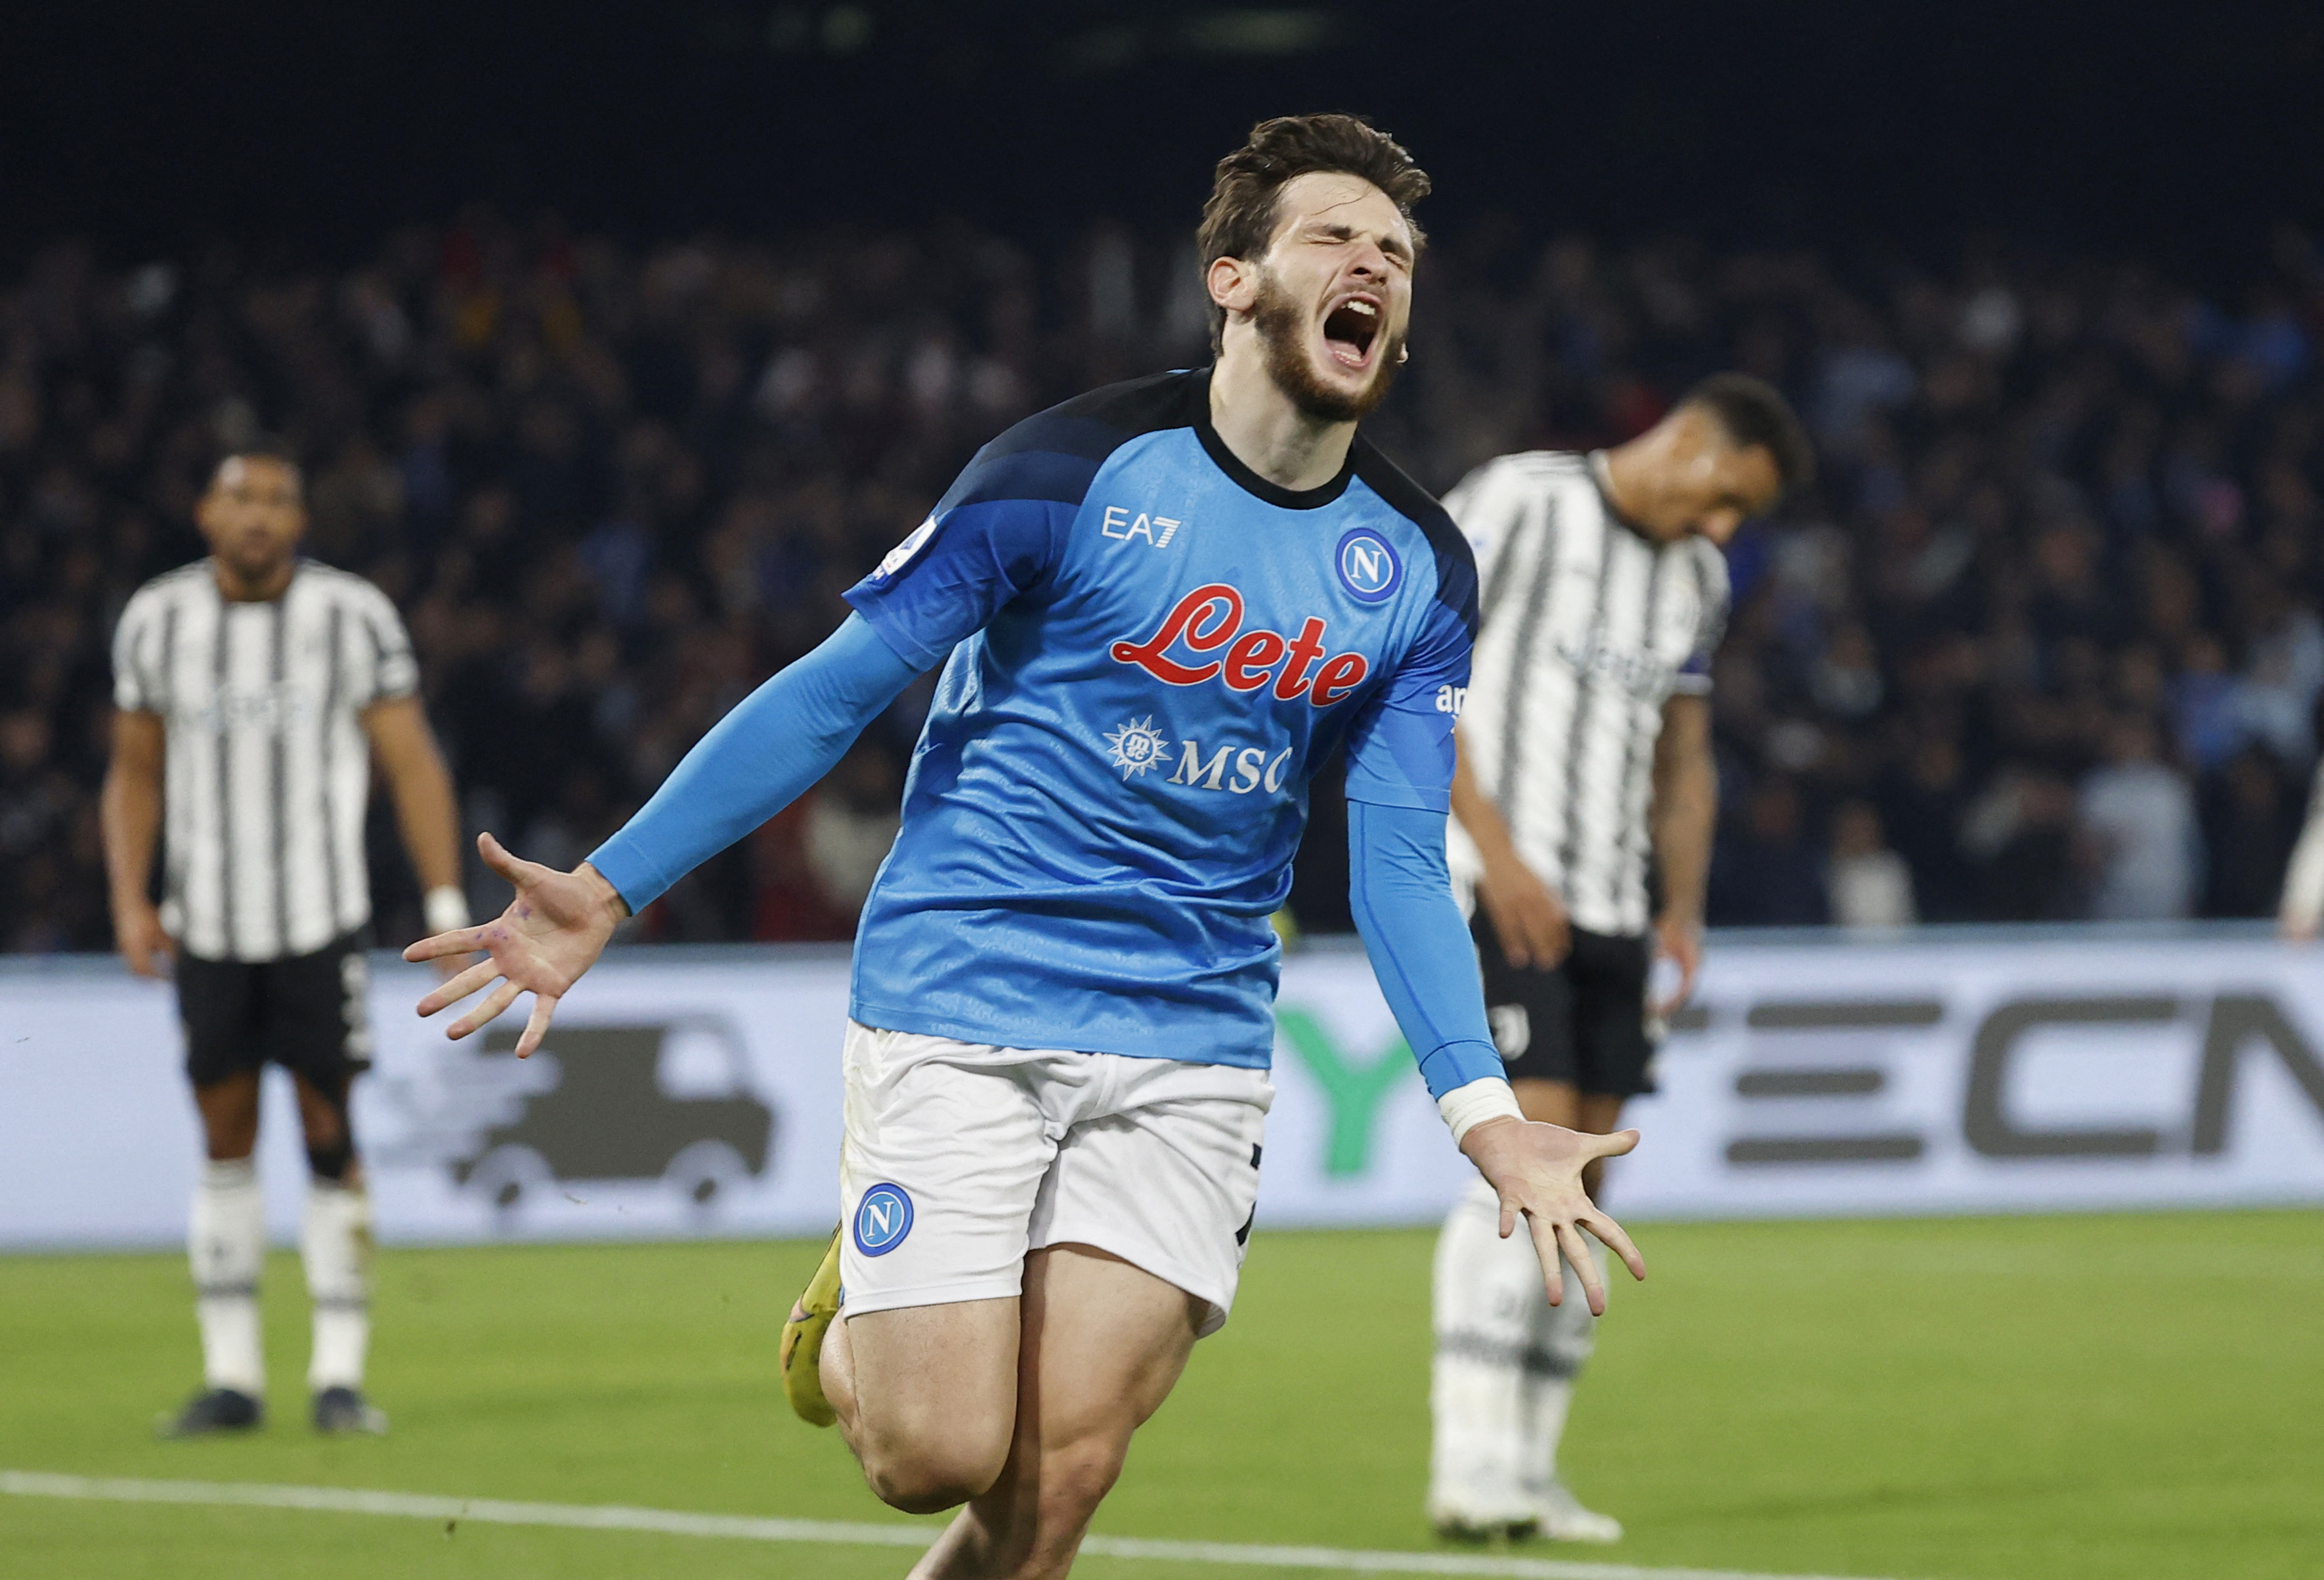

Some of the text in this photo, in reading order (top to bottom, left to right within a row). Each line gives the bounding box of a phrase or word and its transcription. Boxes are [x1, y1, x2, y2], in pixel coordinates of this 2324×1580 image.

[1101, 506, 1182, 548] EA7
[1350, 545, 1382, 583] N
[1110, 582, 1369, 707] Lete
[866, 1201, 894, 1237] N
